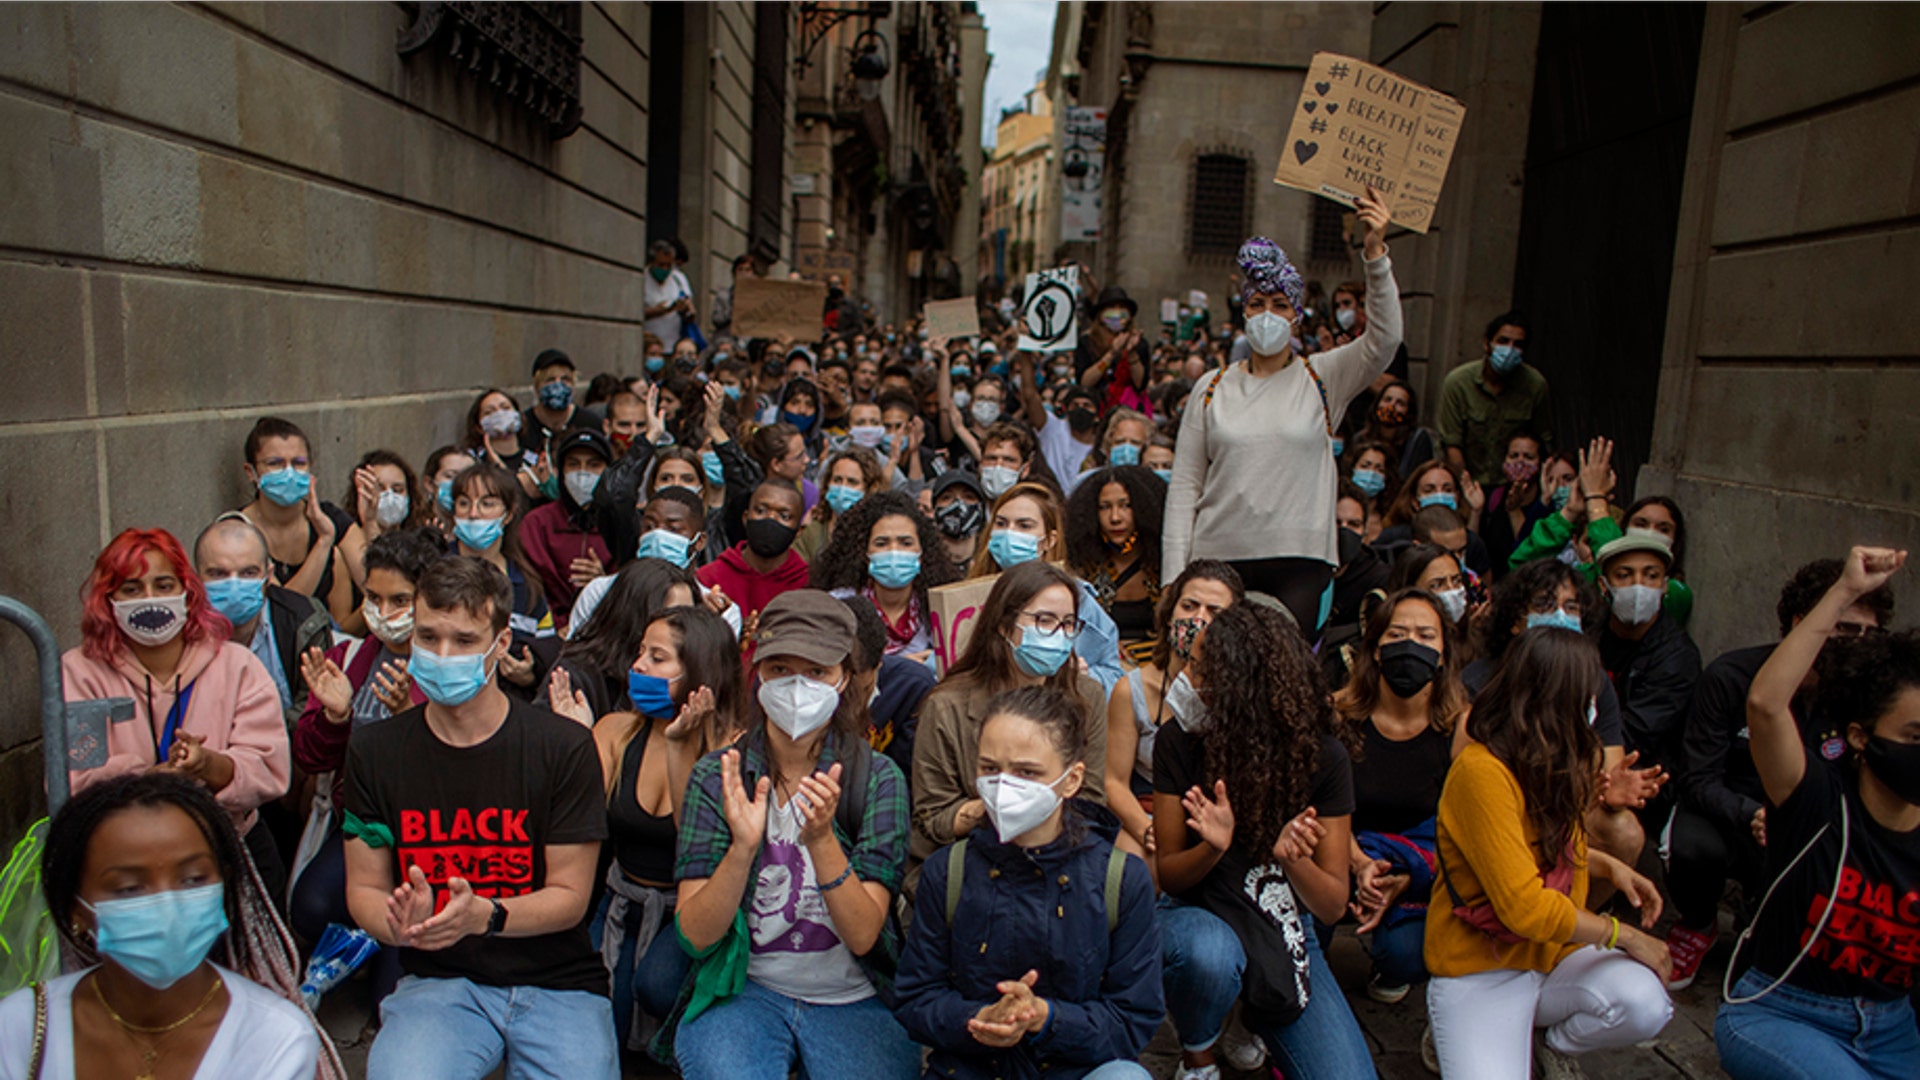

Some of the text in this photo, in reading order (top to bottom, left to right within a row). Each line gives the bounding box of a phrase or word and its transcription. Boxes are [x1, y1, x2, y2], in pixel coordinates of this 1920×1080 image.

[1354, 69, 1363, 88] I
[1346, 97, 1414, 136] BREATH
[1338, 126, 1388, 158] BLACK
[1424, 121, 1449, 141] WE
[1342, 147, 1384, 173] LIVES
[1416, 141, 1446, 158] LOVE
[400, 808, 530, 843] BLACK
[404, 853, 530, 880] LIVES
